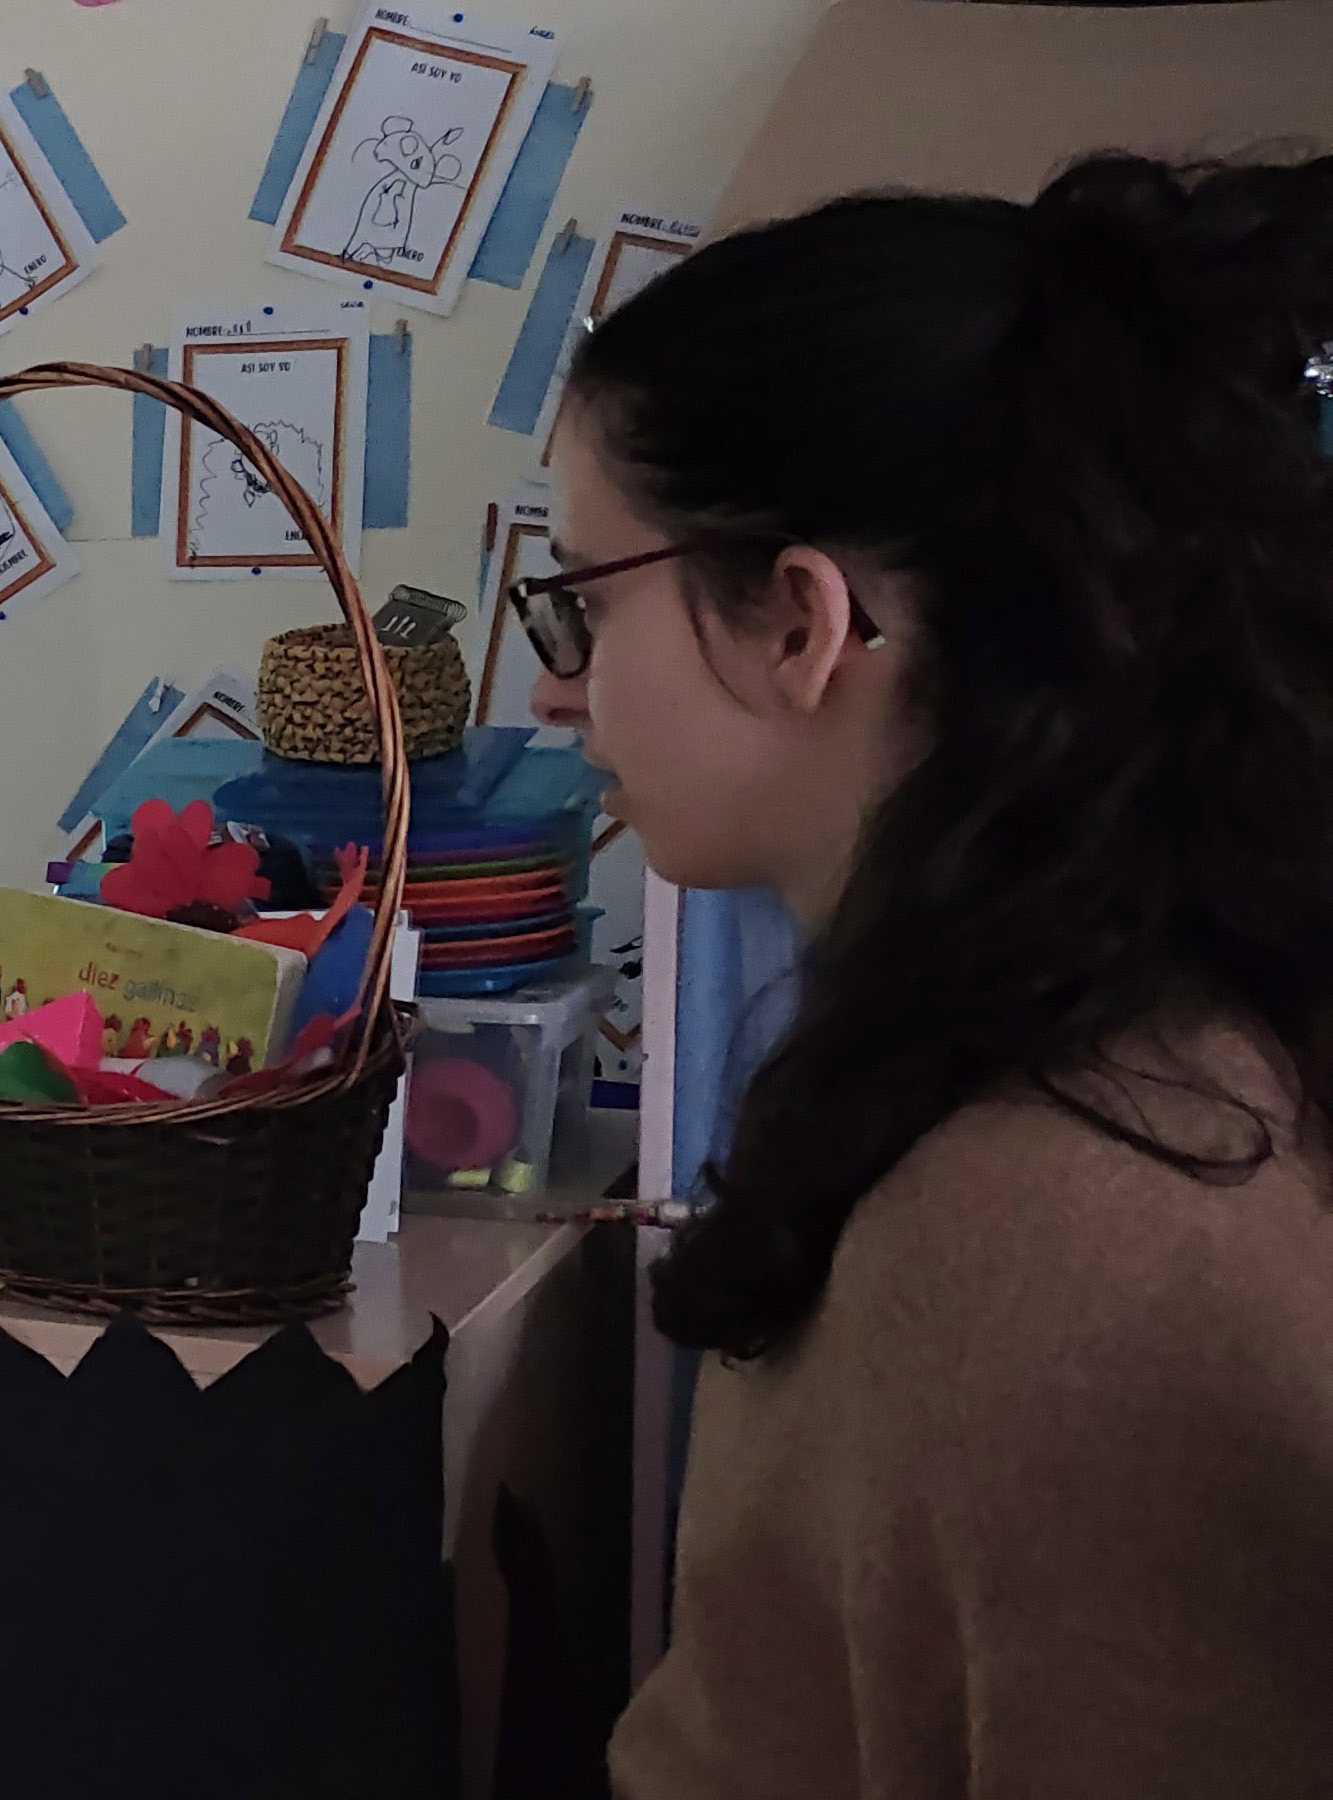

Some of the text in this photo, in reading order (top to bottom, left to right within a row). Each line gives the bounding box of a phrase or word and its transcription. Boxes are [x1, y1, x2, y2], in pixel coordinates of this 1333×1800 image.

[429, 66, 447, 79] SOY
[450, 72, 462, 83] YO
[258, 362, 276, 373] SOY
[78, 961, 120, 990] diez
